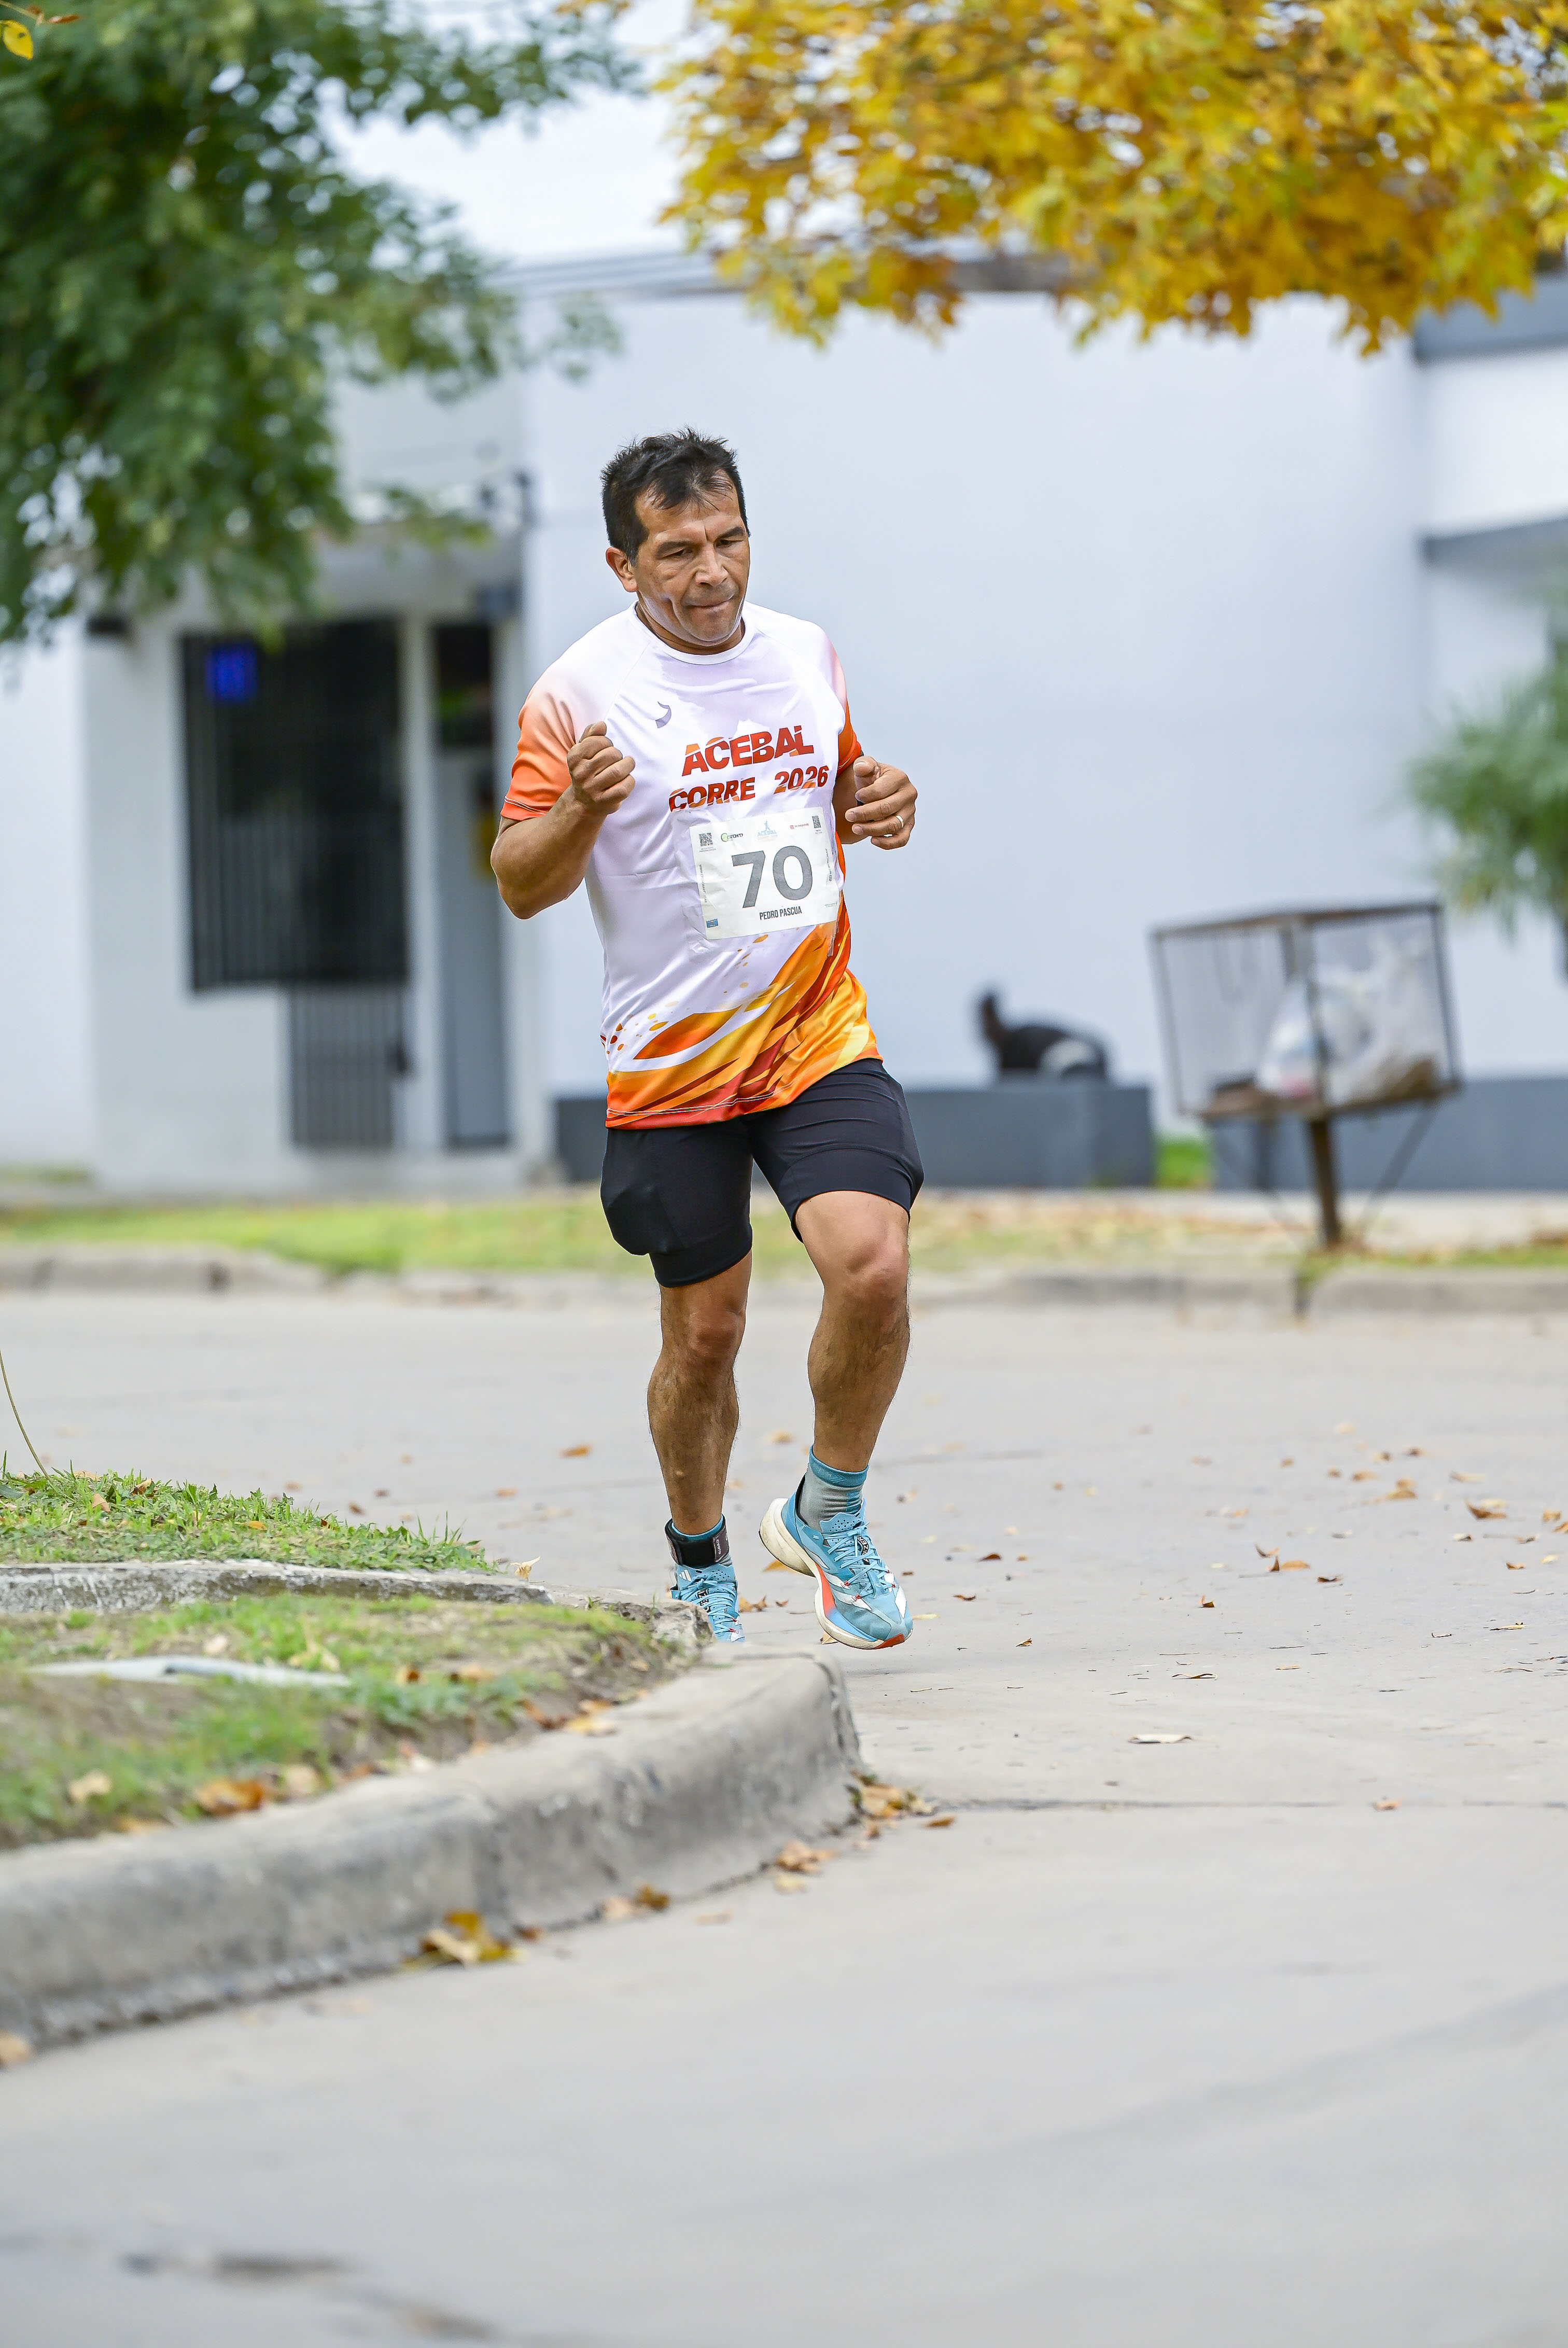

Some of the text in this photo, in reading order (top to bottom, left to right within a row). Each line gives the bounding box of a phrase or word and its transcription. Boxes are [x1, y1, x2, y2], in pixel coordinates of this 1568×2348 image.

[682, 725, 814, 776] ACEBAL
[668, 765, 829, 812] CORRE 2026
[731, 845, 813, 909] 70
[759, 906, 803, 920] PEDRO PASCUA
